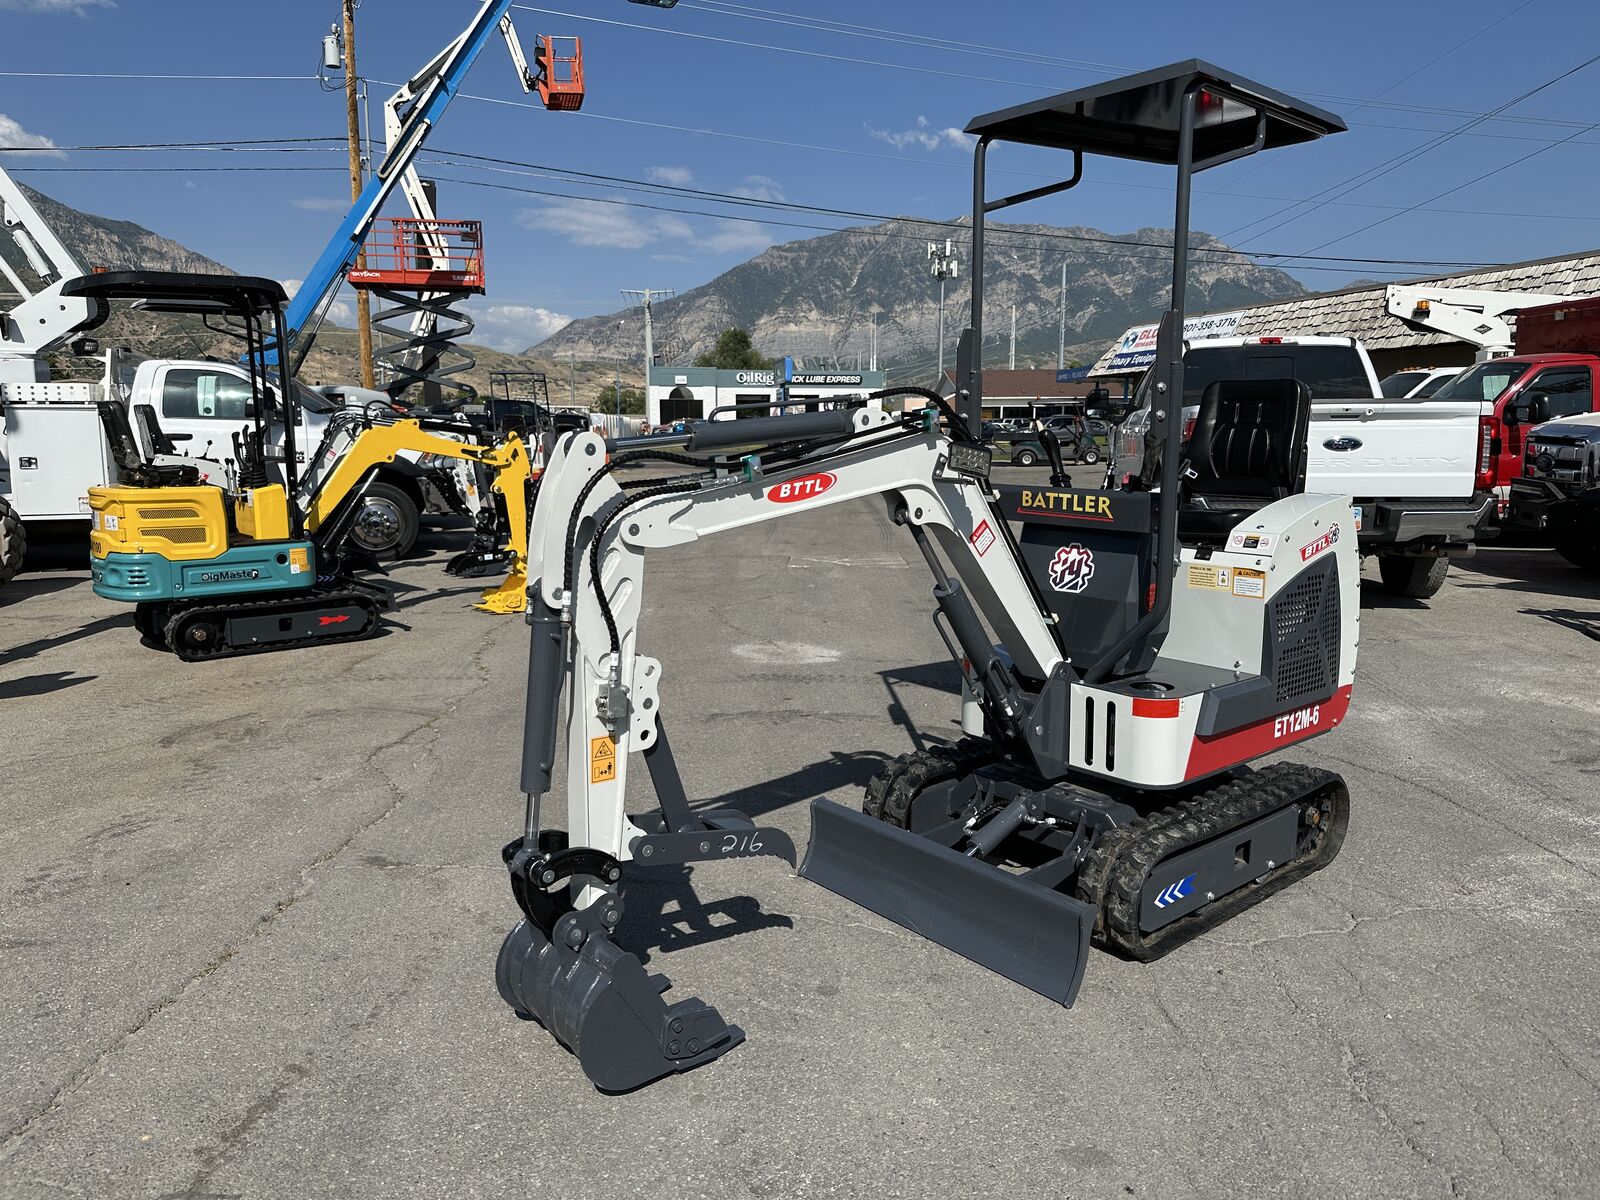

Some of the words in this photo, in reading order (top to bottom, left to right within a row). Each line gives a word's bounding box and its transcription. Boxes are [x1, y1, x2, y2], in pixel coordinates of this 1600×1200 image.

[1183, 317, 1237, 333] 801-358-3716
[1113, 356, 1132, 367] Heavy
[806, 375, 825, 383] LUBE
[826, 375, 860, 383] EXPRESS
[1363, 457, 1461, 467] DUTY
[779, 478, 824, 498] BTTL
[1022, 490, 1113, 519] BATTLER
[1304, 537, 1328, 559] BTTL
[202, 569, 258, 582] DigMaster
[1273, 705, 1320, 738] ET12M-6
[721, 832, 763, 853] 216
